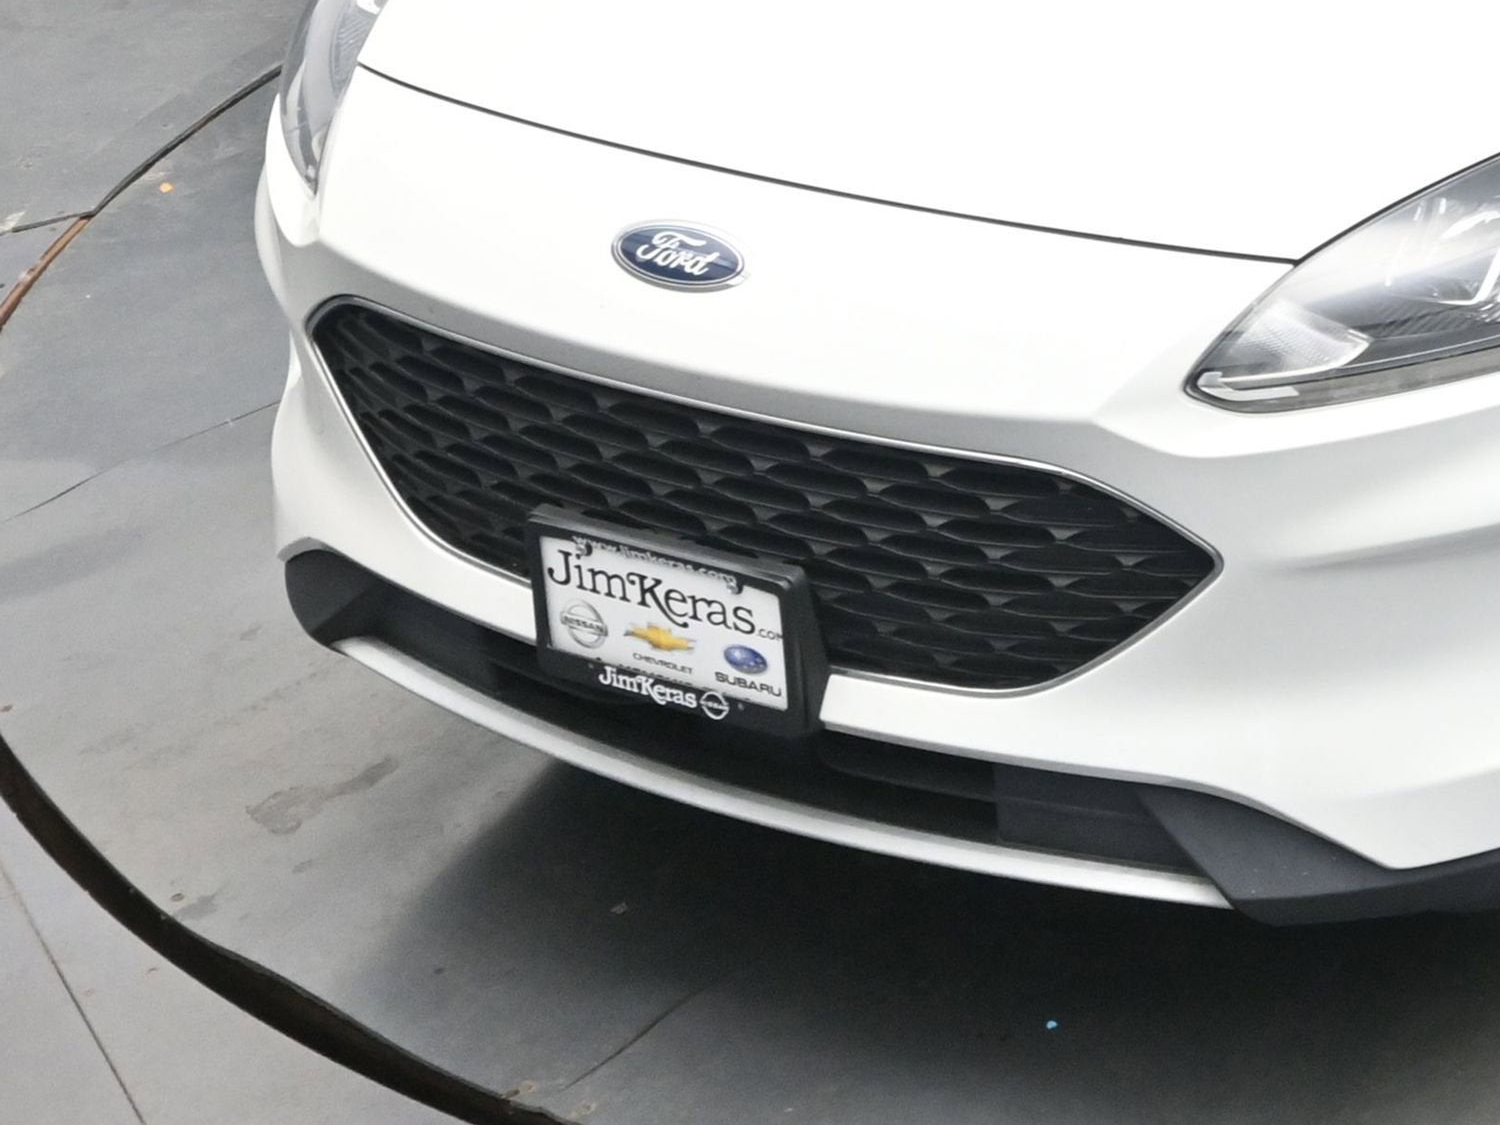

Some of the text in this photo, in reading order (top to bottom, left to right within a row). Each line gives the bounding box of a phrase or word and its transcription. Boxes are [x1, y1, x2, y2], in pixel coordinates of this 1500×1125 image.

[636, 230, 720, 276] Ford
[632, 652, 694, 675] CHEVROLET
[598, 665, 697, 709] JimKeras
[714, 671, 783, 697] SUBARU
